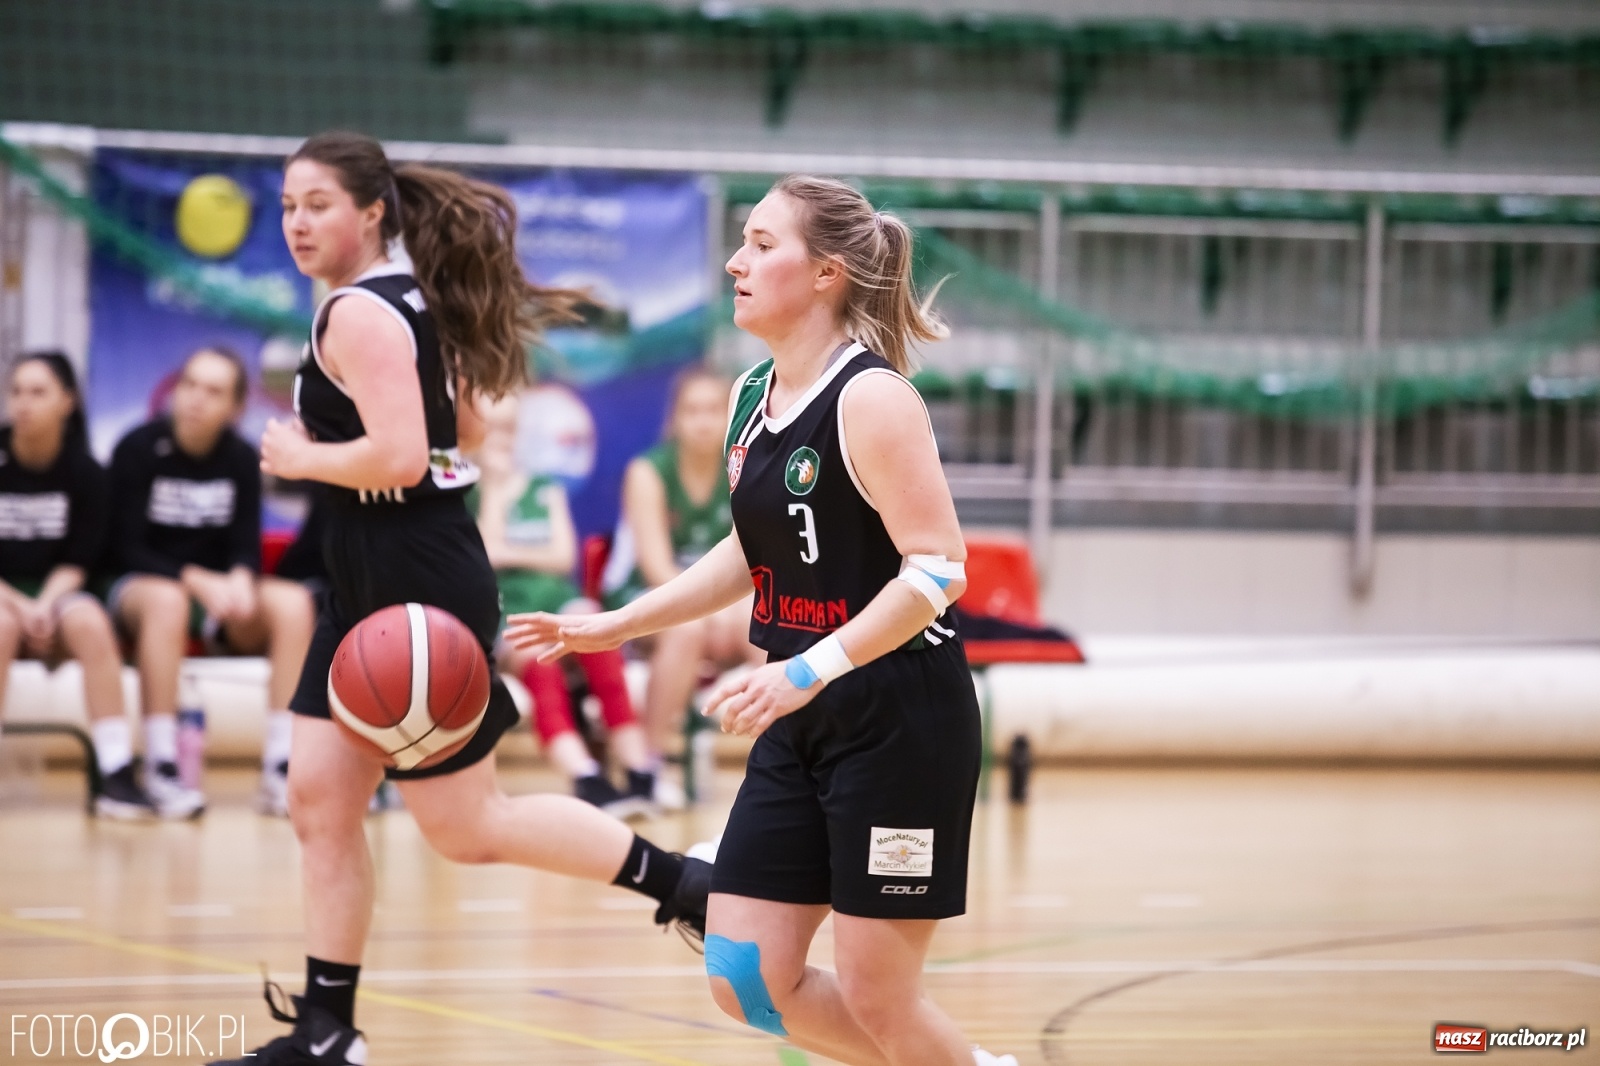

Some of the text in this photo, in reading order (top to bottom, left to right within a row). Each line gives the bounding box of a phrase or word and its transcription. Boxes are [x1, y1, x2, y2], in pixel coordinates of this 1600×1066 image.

[788, 503, 820, 565] 3
[779, 595, 848, 628] KAMAN
[876, 833, 928, 849] MoceNatury.pl
[874, 860, 901, 869] Marcin
[880, 885, 928, 894] COLO
